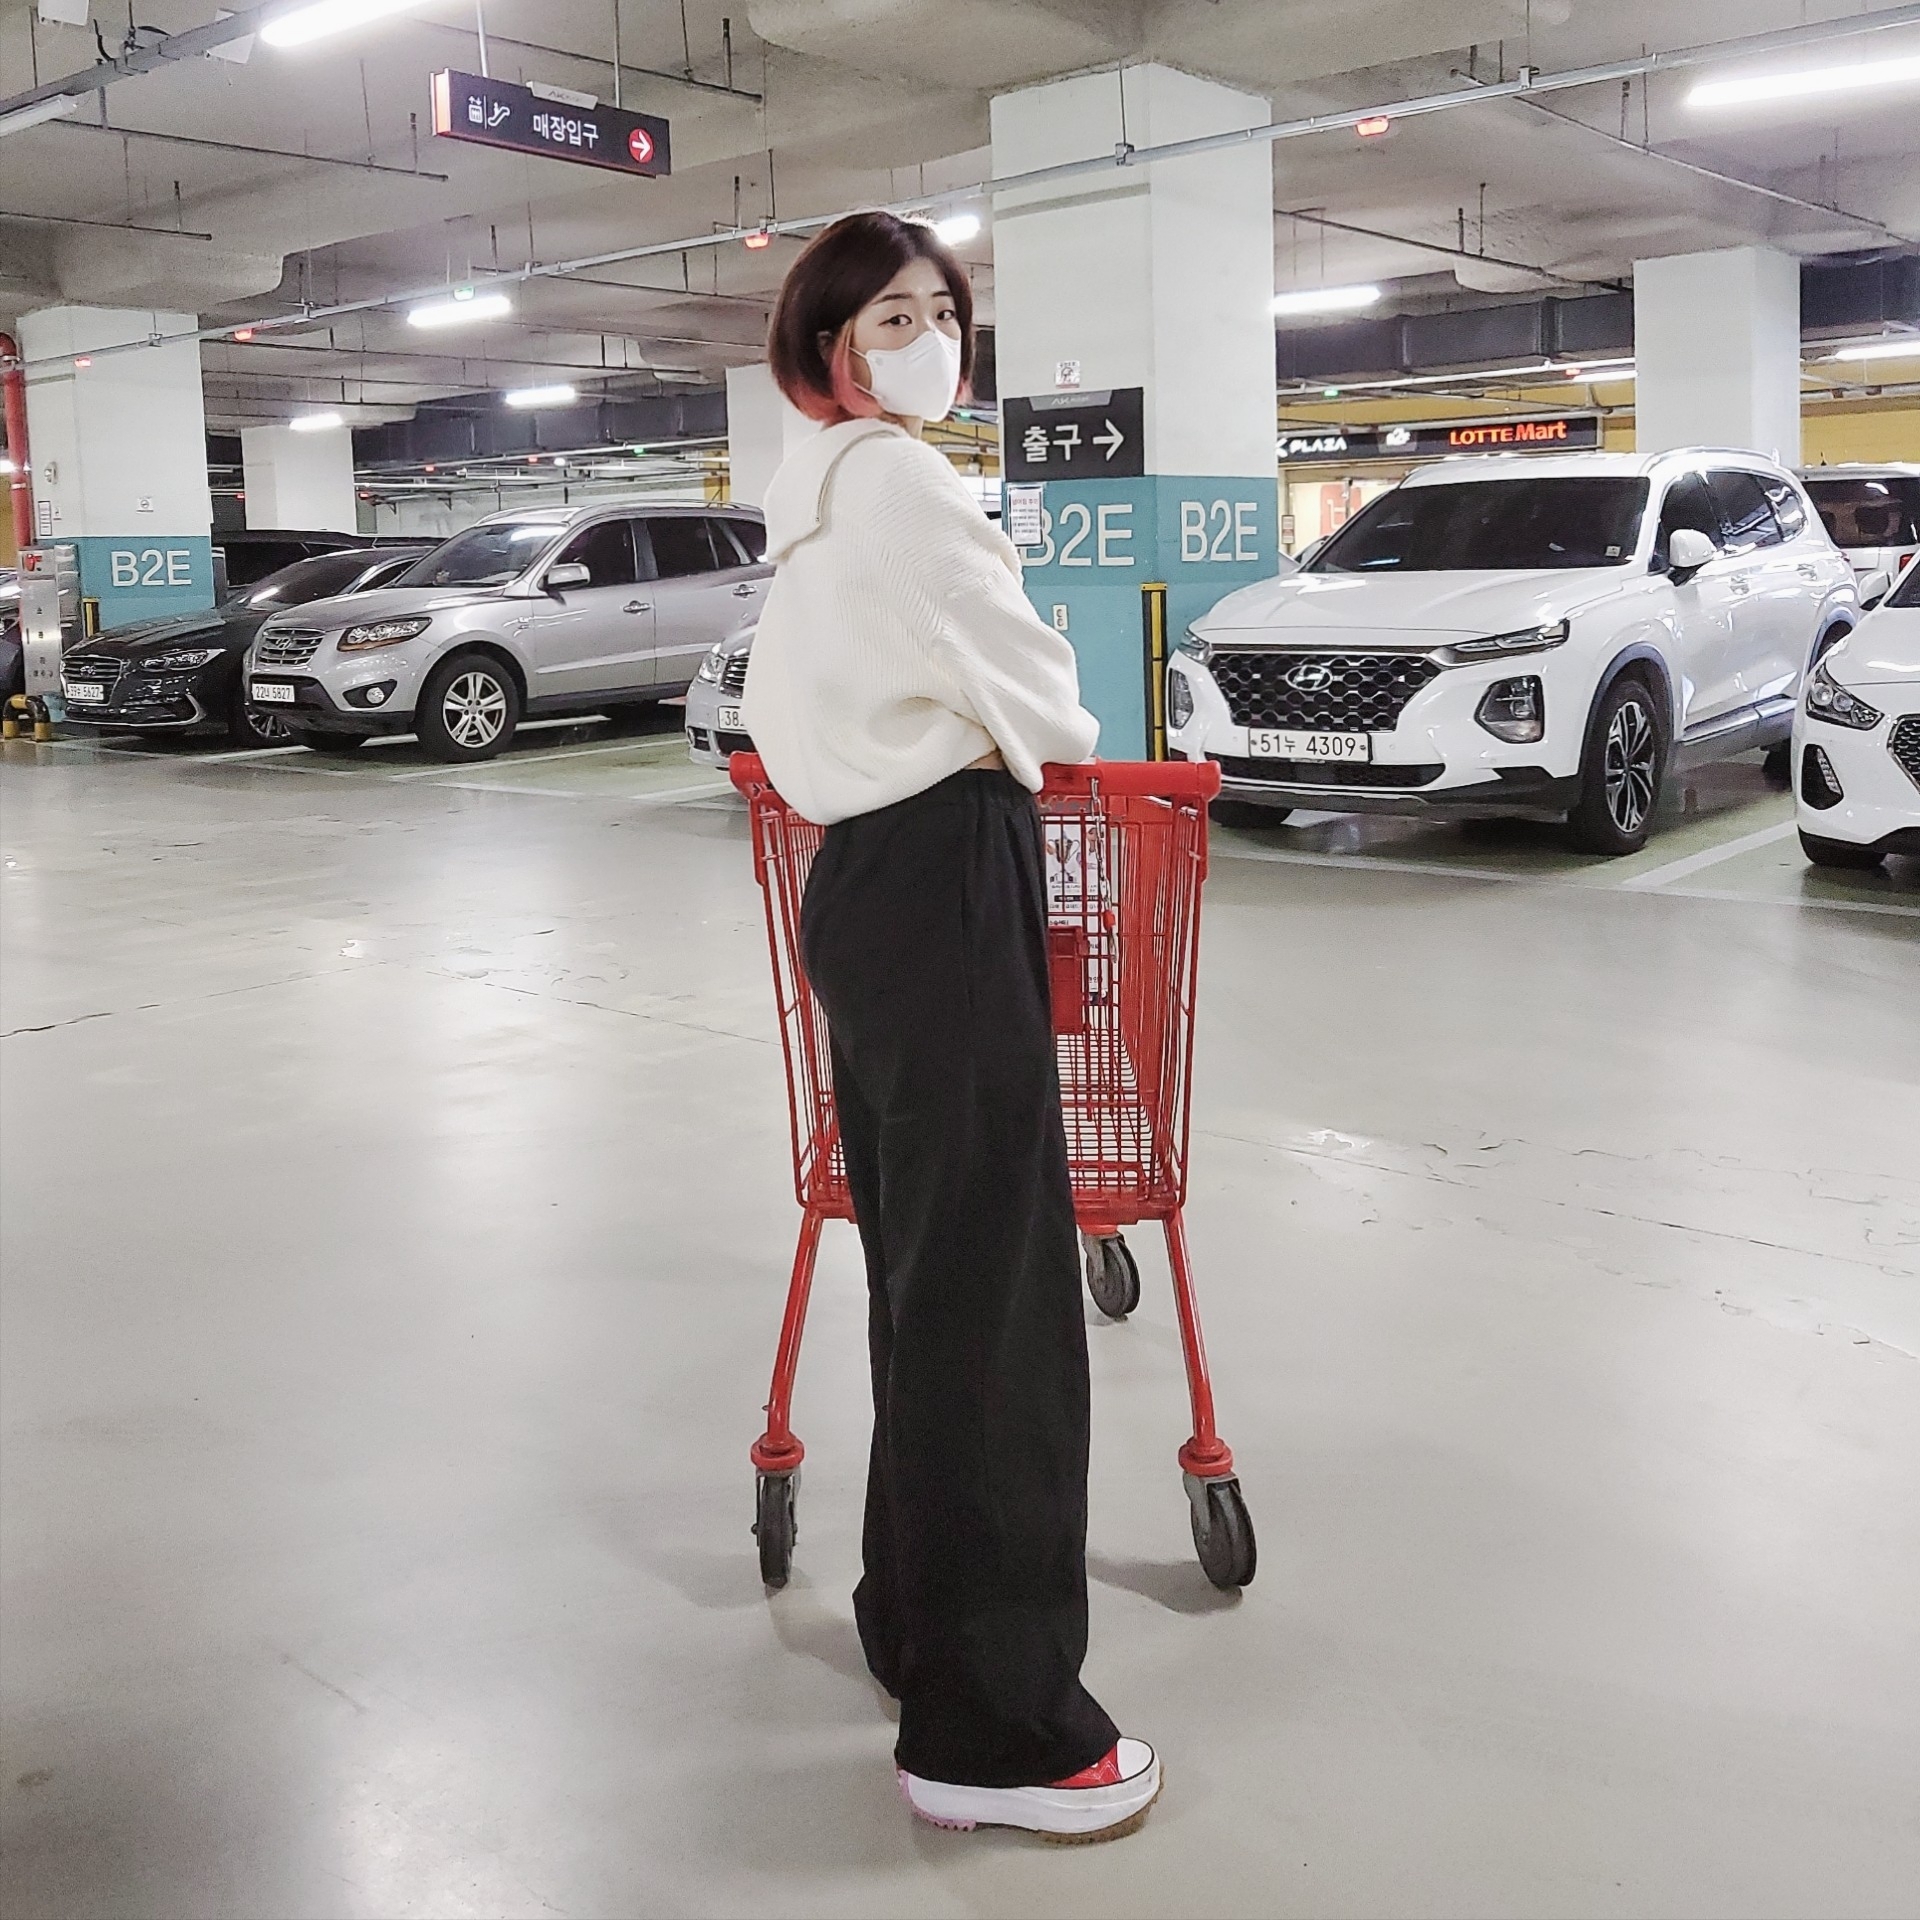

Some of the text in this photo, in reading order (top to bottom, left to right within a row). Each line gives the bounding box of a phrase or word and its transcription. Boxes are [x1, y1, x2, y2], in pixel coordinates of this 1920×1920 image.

[533, 113, 599, 149] 매장입구
[1022, 424, 1082, 463] 출구
[1290, 436, 1347, 453] PLAZA
[1450, 421, 1567, 446] LOTTE Mart
[1180, 499, 1259, 562] B2E
[111, 548, 192, 587] B2E
[1260, 733, 1357, 757] 51누 4309
